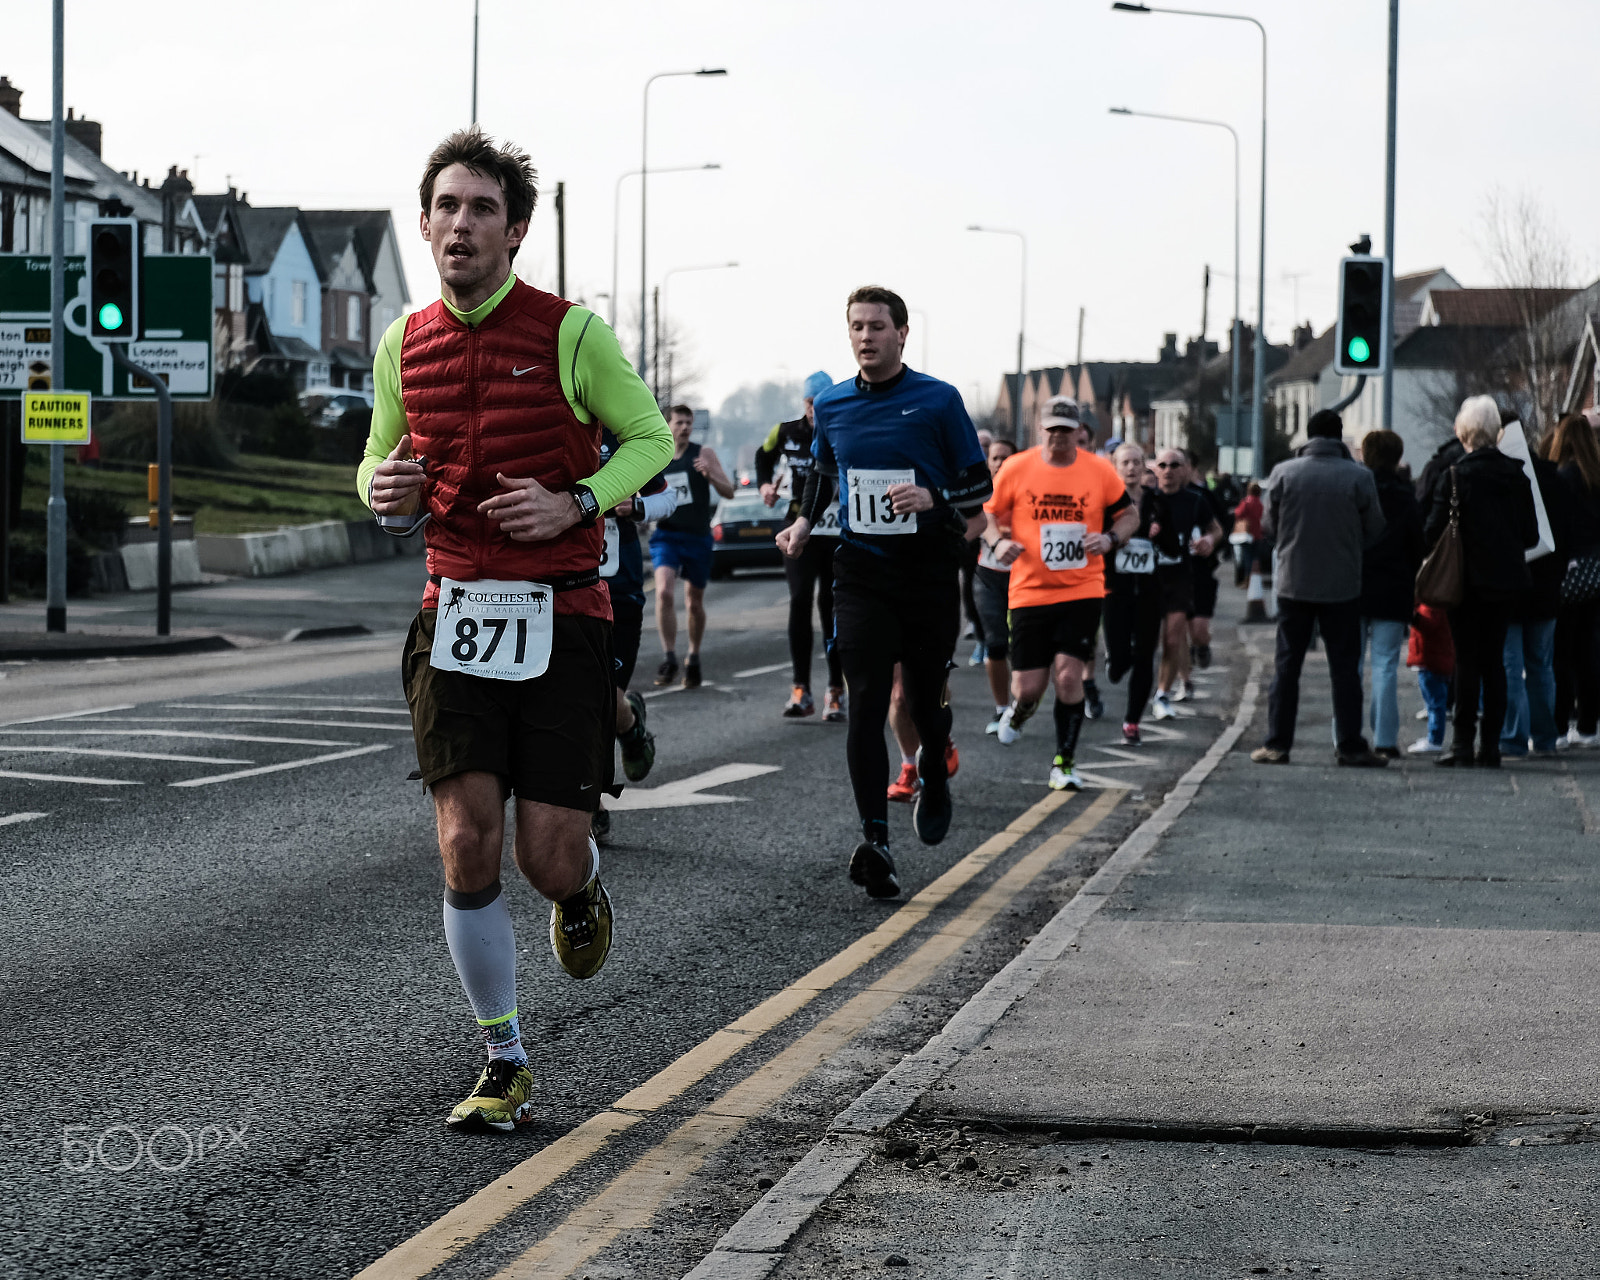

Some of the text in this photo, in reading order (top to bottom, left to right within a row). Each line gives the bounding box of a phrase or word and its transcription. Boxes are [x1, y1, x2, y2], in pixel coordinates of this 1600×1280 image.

[133, 347, 178, 357] London
[31, 400, 81, 412] CAUTION
[28, 417, 83, 429] RUNNERS
[1032, 508, 1084, 522] JAMES
[1043, 540, 1085, 563] 2306
[1122, 551, 1149, 569] 709
[468, 606, 547, 614] HALF MARATHON
[451, 617, 527, 664] 871
